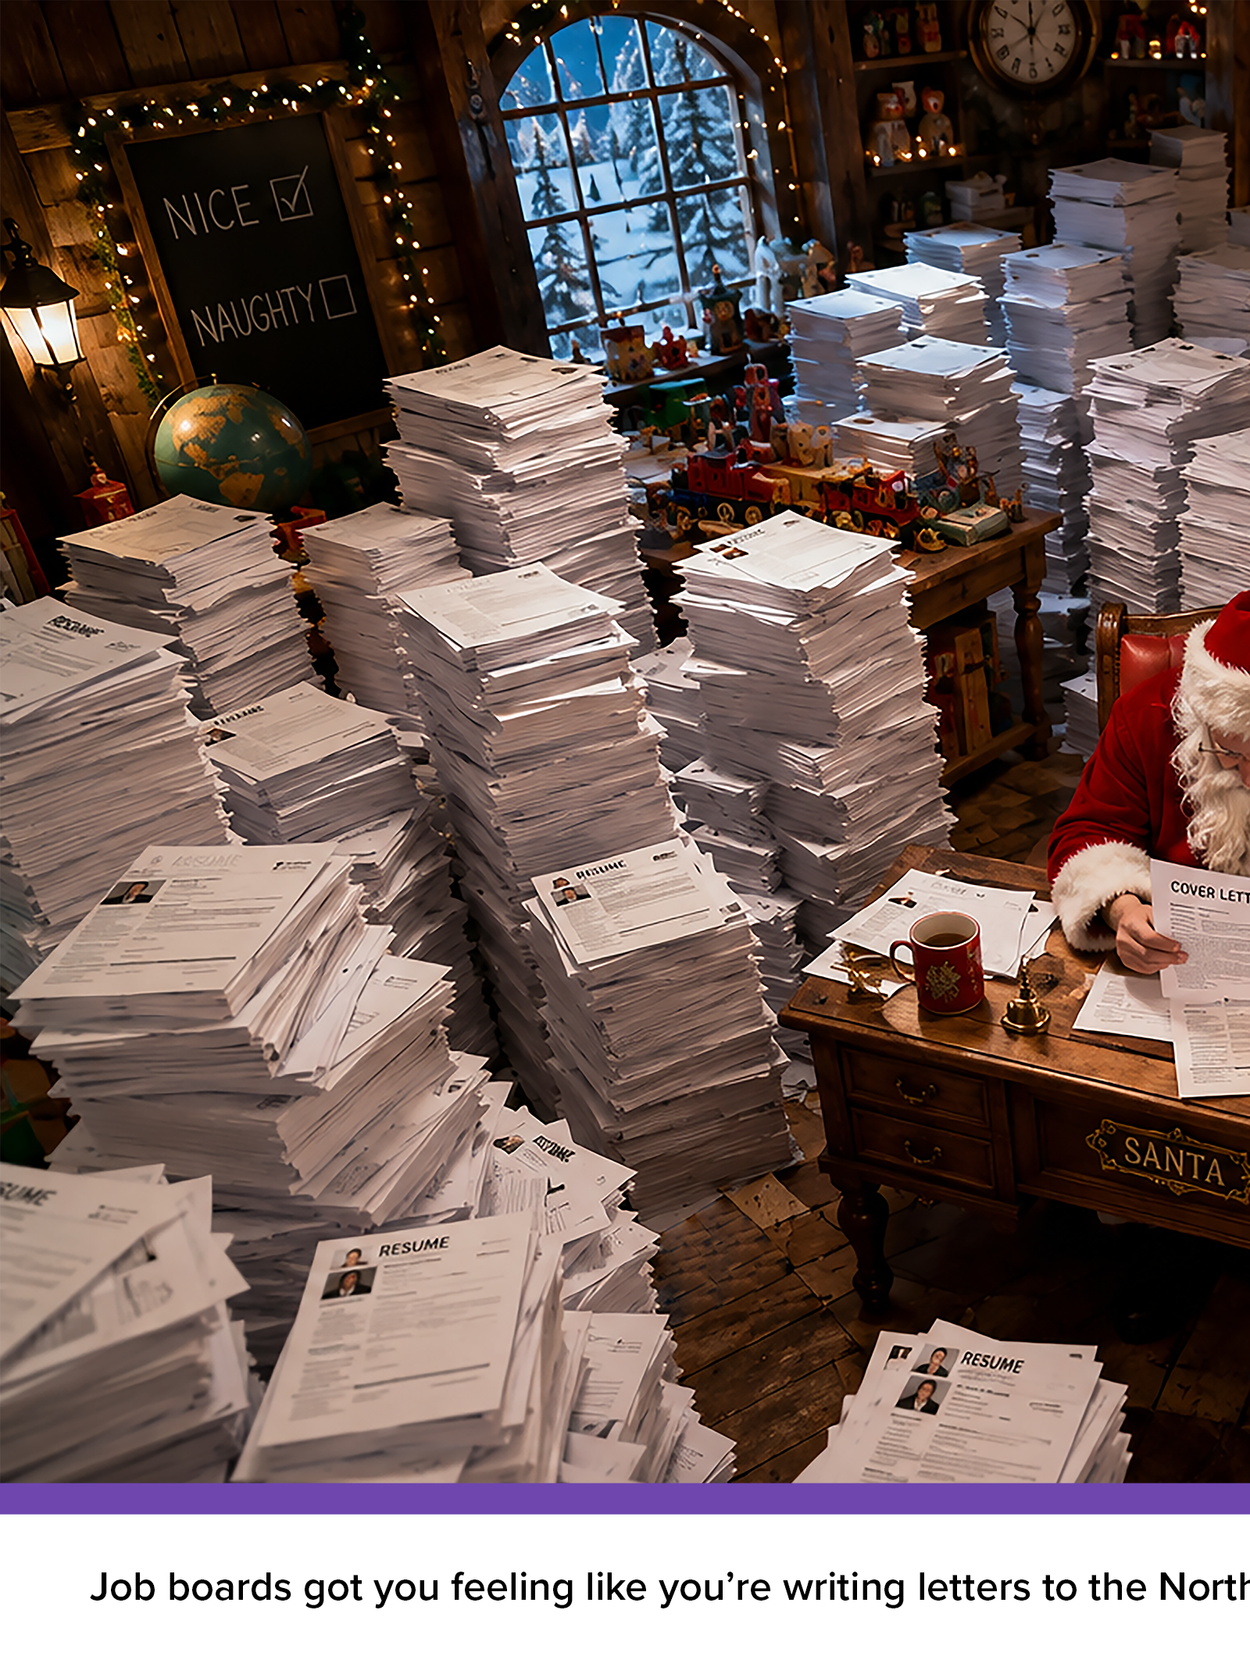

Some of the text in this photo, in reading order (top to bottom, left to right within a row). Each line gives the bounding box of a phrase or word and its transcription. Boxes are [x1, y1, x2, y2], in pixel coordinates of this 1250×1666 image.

[162, 183, 260, 240] NICE
[189, 282, 316, 347] NAUGHTY
[1170, 880, 1216, 899] COVER
[1124, 1136, 1226, 1187] SANTA
[378, 1235, 450, 1258] RESUME
[960, 1350, 1025, 1375] RESUME
